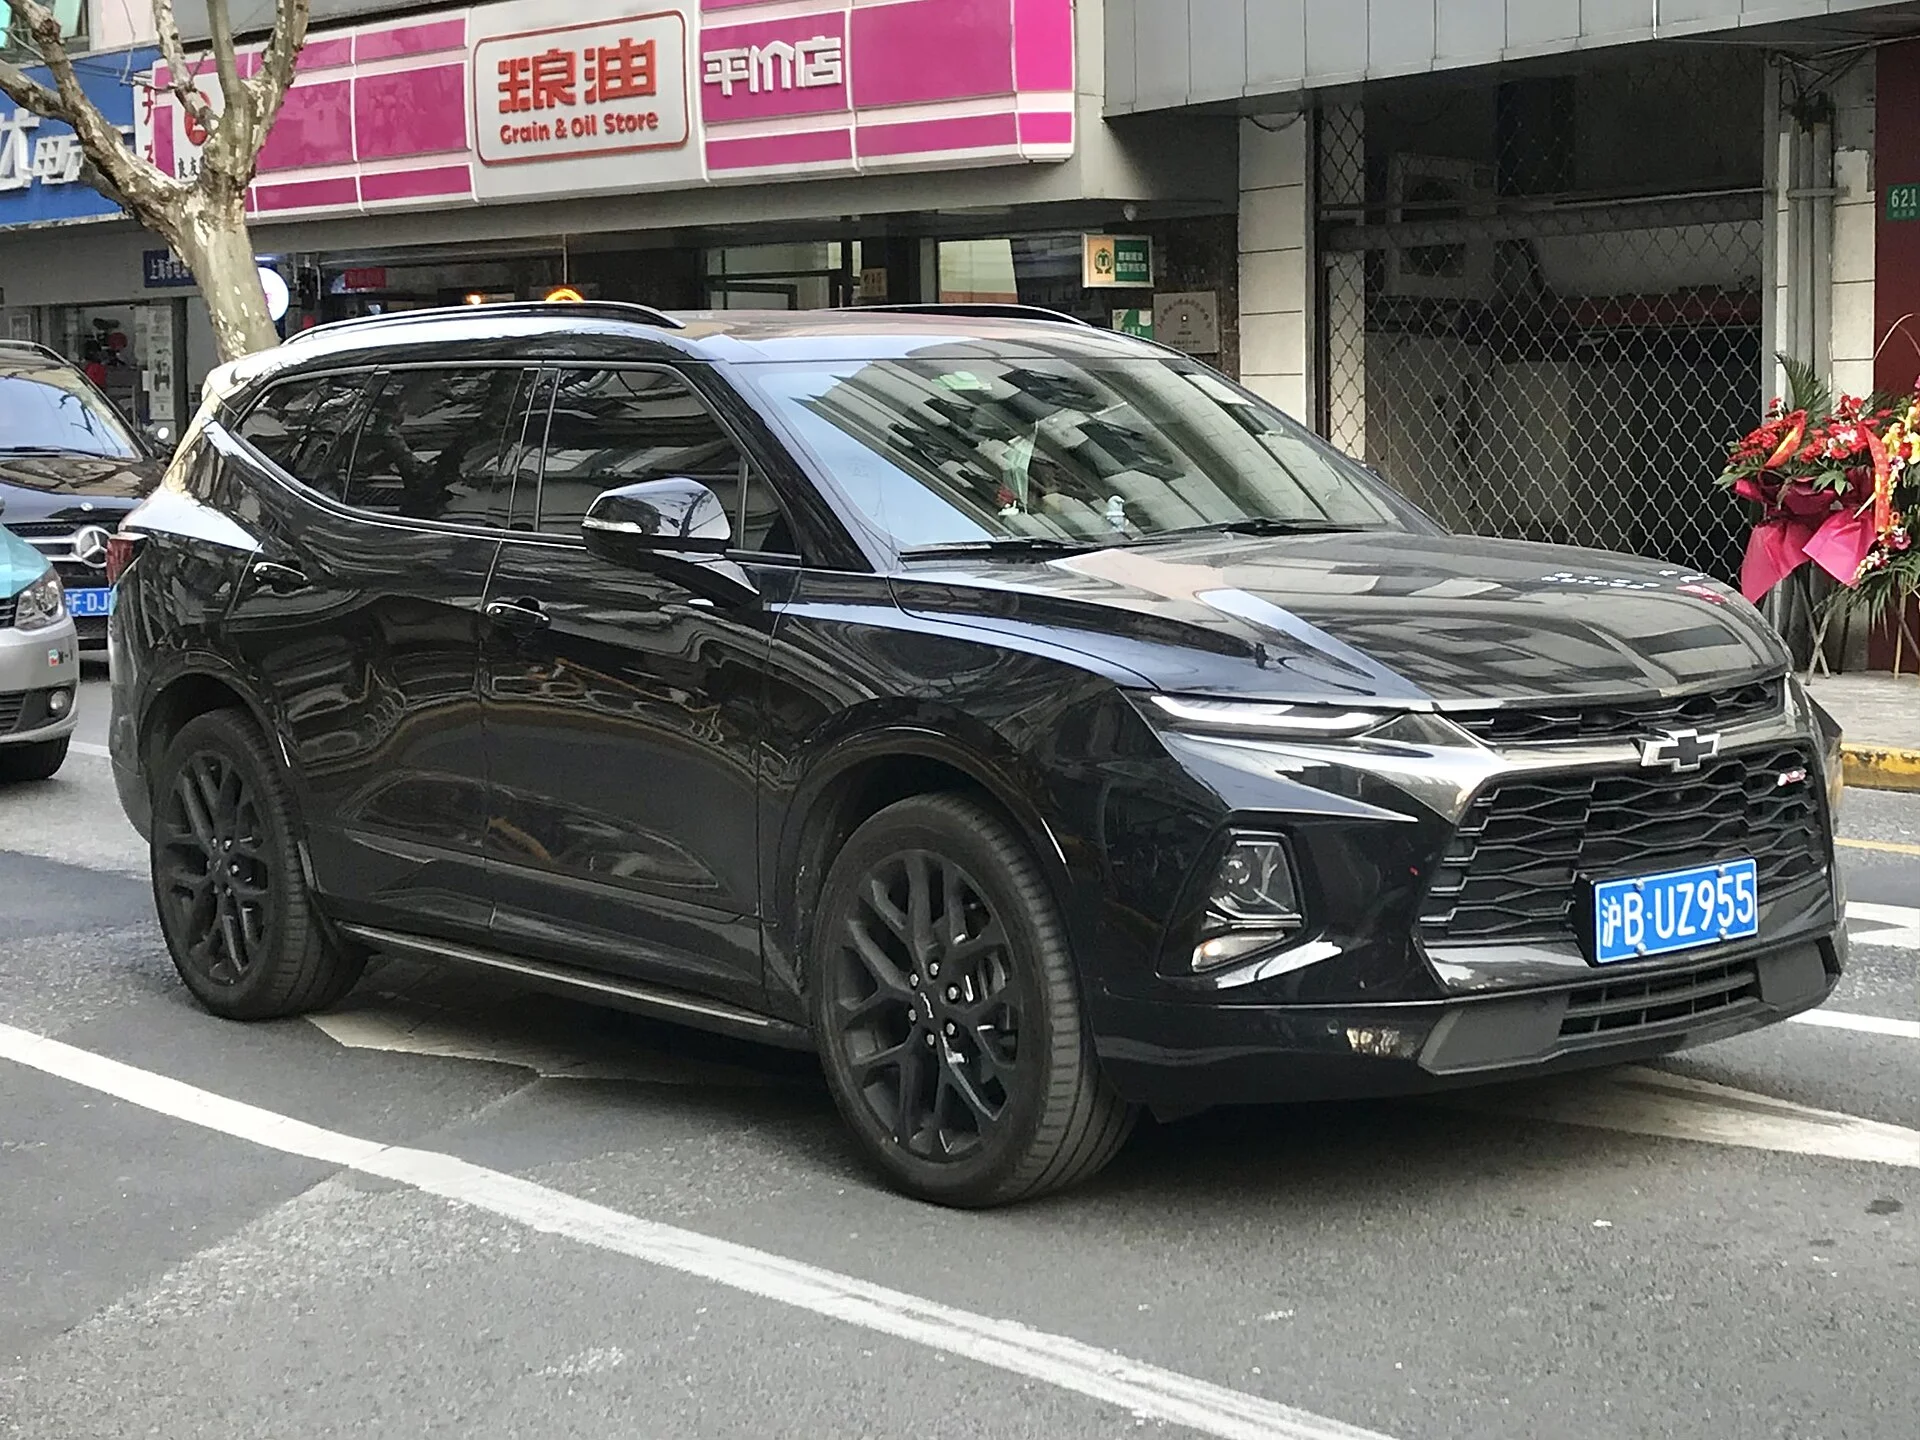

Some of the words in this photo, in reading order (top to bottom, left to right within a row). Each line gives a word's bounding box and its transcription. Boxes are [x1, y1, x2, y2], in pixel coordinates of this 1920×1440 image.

[498, 38, 657, 114] 粮油
[703, 36, 842, 97] 平价店
[501, 121, 550, 144] Grain
[555, 118, 567, 139] &
[571, 114, 598, 137] Oil
[604, 111, 659, 134] Store
[1891, 188, 1917, 208] 621
[65, 592, 111, 612] F·DJ
[1602, 871, 1754, 948] 沪B·UZ955
